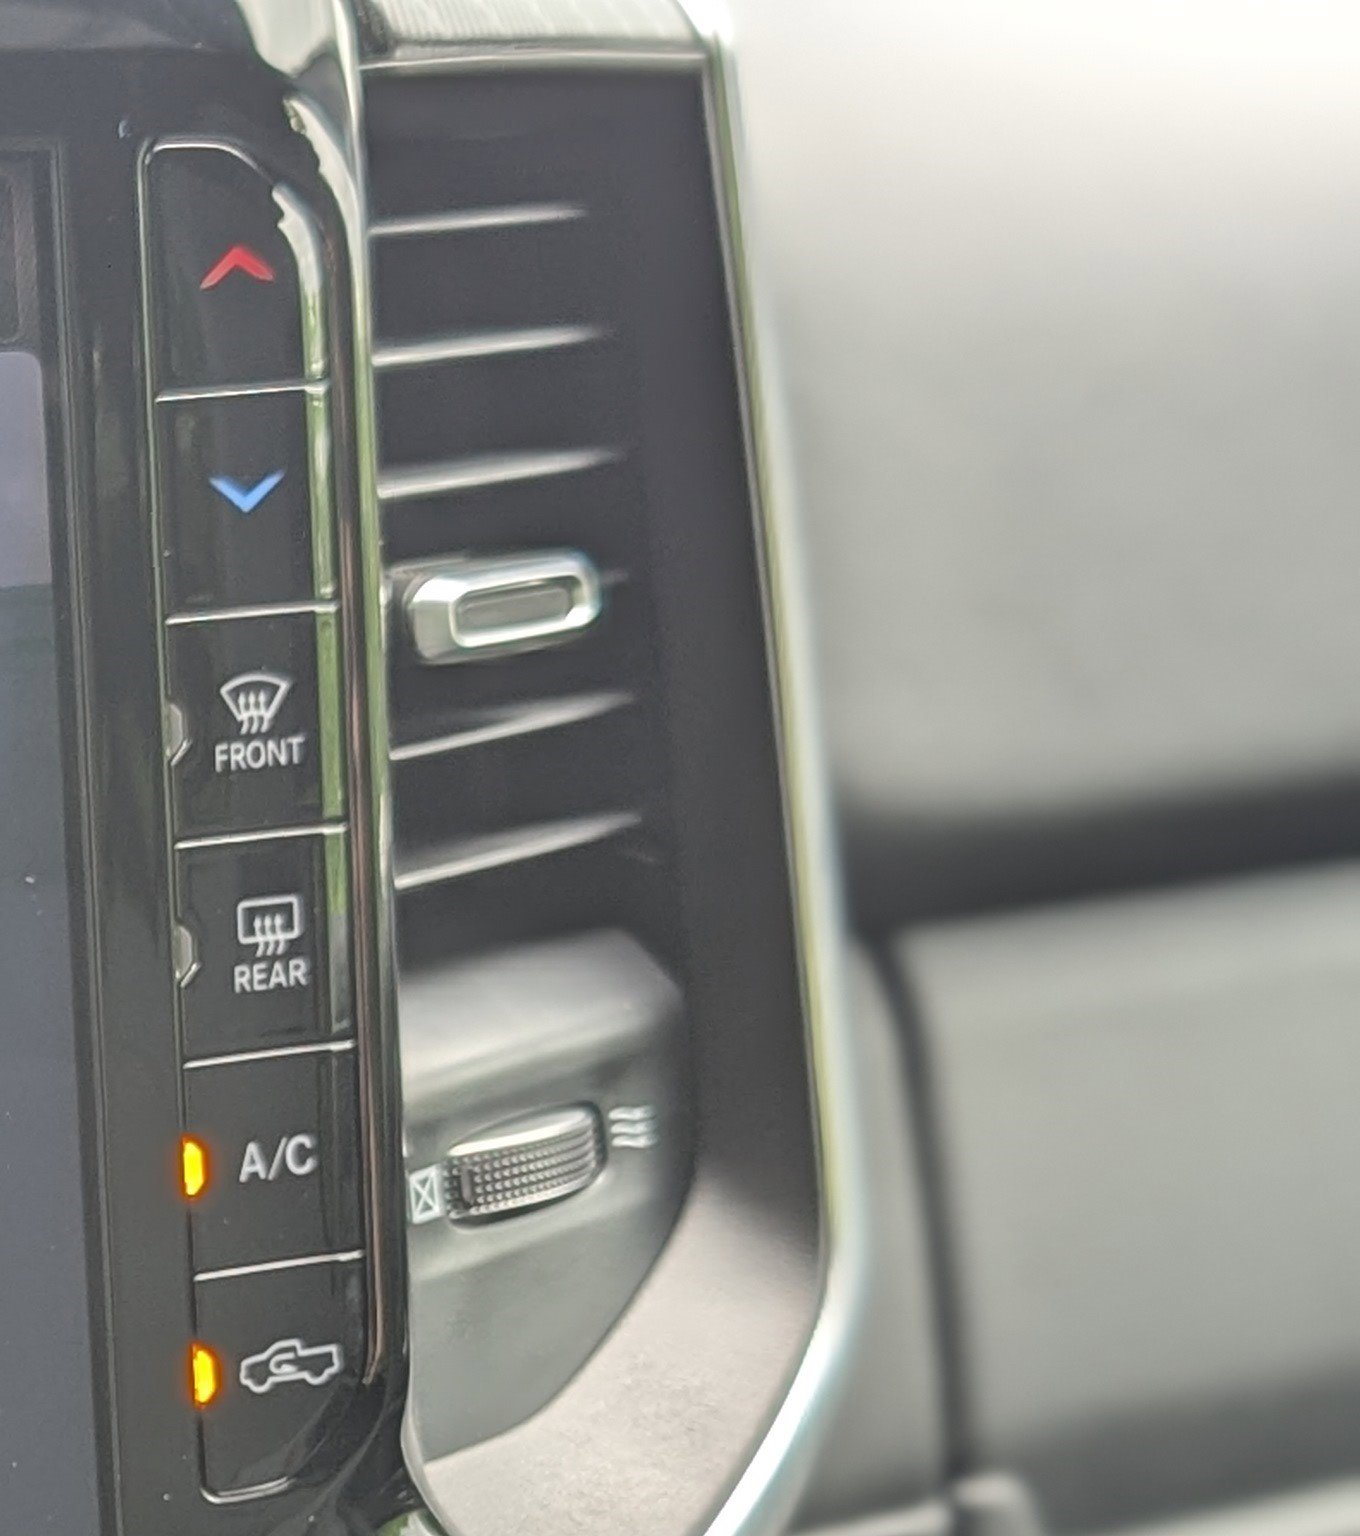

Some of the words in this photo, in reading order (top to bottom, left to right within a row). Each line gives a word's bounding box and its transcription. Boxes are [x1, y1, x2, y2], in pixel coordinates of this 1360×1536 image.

[215, 736, 304, 772] FRONT
[234, 958, 307, 993] REAR
[239, 1134, 316, 1183] A/C
